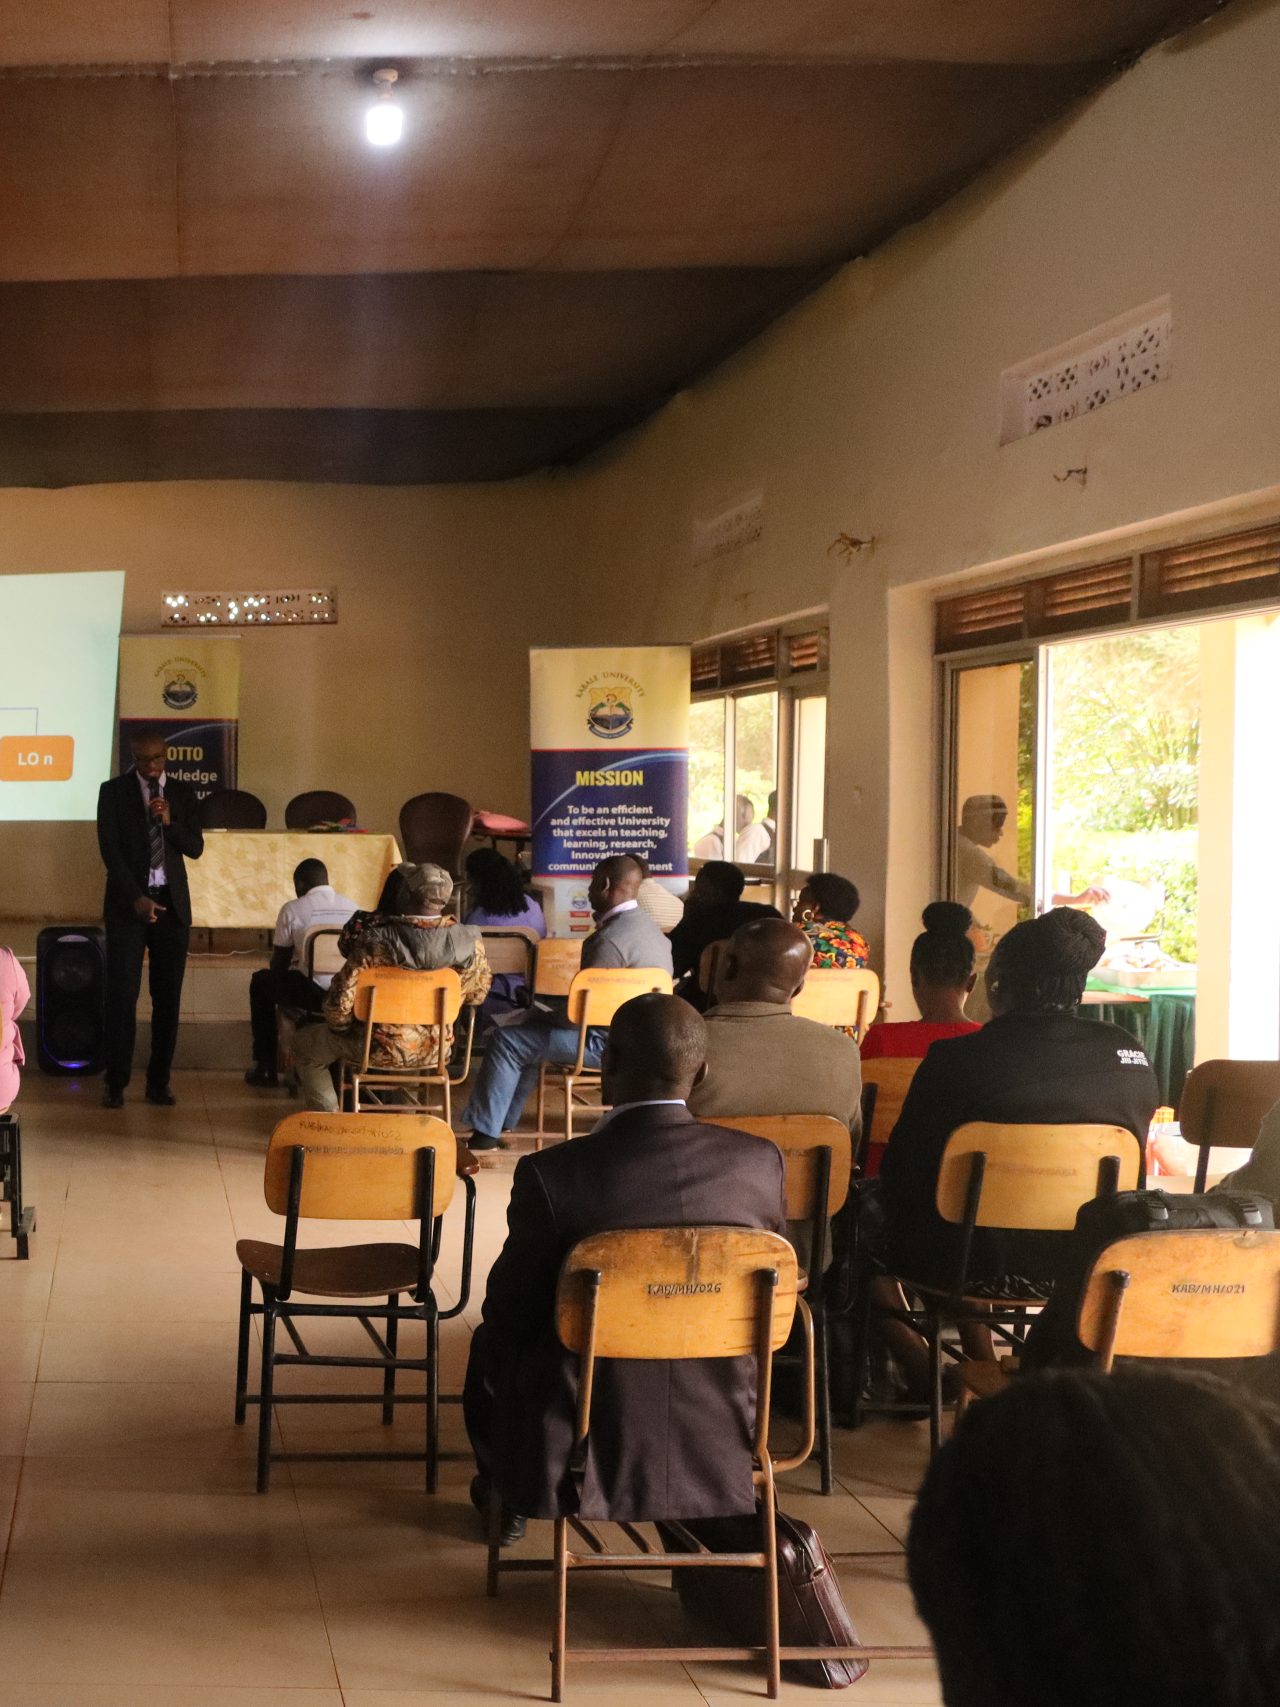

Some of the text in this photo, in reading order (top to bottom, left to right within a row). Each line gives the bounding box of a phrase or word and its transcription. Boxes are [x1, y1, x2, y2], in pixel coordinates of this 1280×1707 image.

[18, 752, 54, 766] LO n
[166, 746, 204, 761] OTTO
[575, 770, 644, 786] MISSION
[567, 805, 580, 814] To
[581, 805, 595, 814] be
[611, 805, 654, 814] efficient
[550, 816, 671, 828] and effective University
[553, 828, 668, 839] that excels in teaching,
[563, 840, 657, 850] learning, research,
[548, 862, 598, 871] communi
[1172, 1284, 1245, 1294] KAB/MH/021
